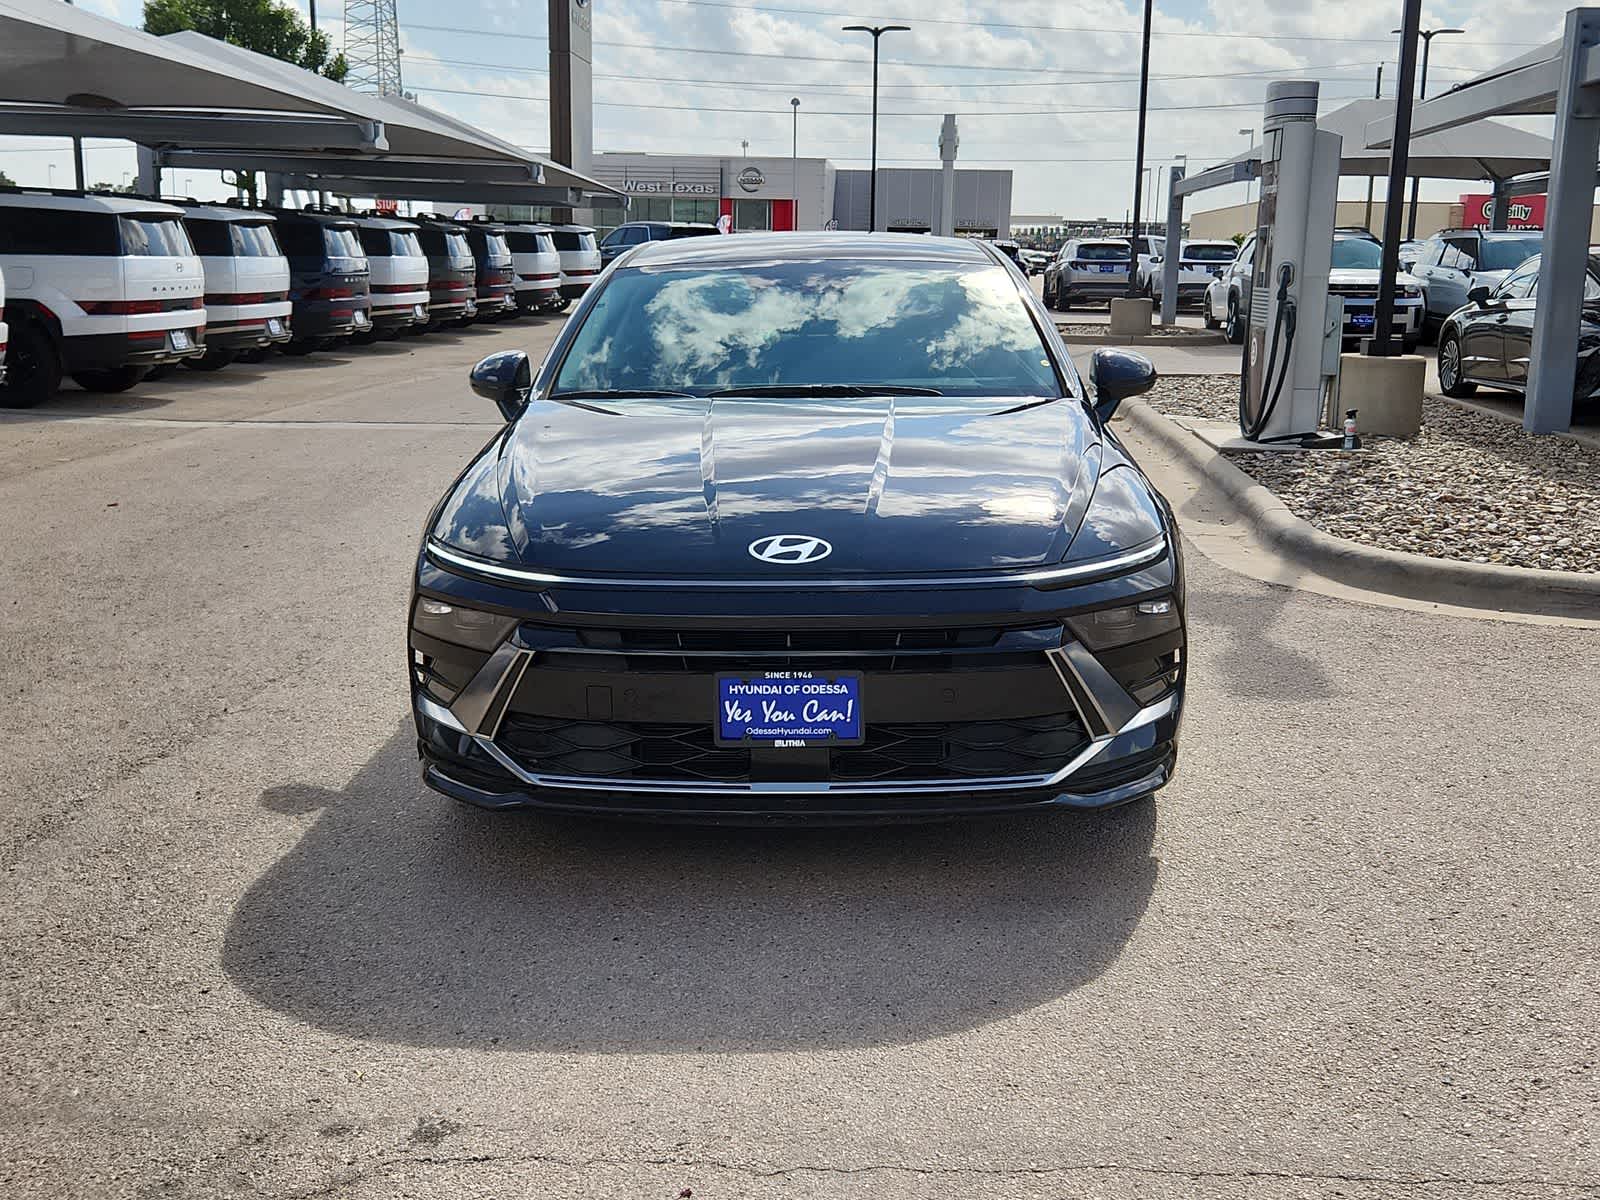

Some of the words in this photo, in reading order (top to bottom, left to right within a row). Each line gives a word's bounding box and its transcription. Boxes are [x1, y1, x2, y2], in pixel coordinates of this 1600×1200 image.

[622, 180, 662, 193] West
[667, 181, 714, 194] Texas
[376, 200, 397, 210] STOP
[764, 671, 791, 679] SINCE
[793, 671, 813, 679] 1946
[729, 685, 782, 695] HYUNDAI
[784, 685, 800, 695] OF
[802, 684, 849, 695] ODESSA
[724, 699, 752, 723] Yes
[761, 699, 796, 723] You
[802, 699, 854, 723] Can!
[746, 727, 832, 736] OdessaHyundai.com
[781, 739, 806, 747] LITHIA
